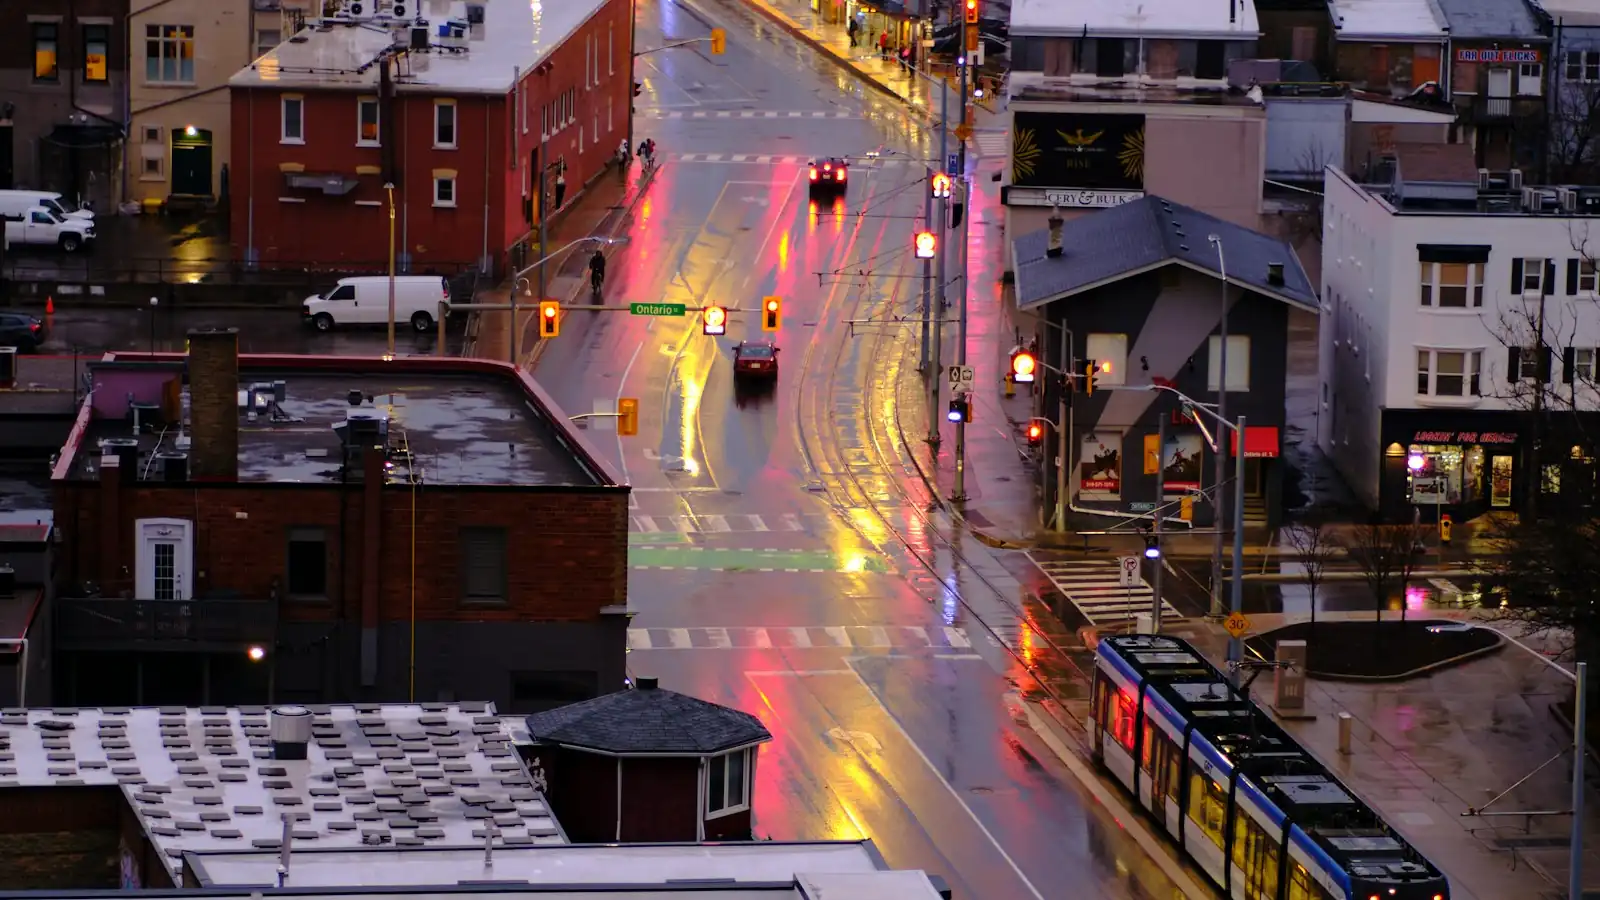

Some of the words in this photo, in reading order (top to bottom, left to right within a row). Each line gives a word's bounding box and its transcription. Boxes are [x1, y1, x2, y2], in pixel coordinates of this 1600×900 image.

[1459, 50, 1478, 61] FAR
[1481, 50, 1499, 61] OUT
[1502, 50, 1537, 62] FLICKS
[1066, 158, 1092, 169] RISE
[1078, 191, 1095, 205] &
[636, 304, 672, 315] Ontario
